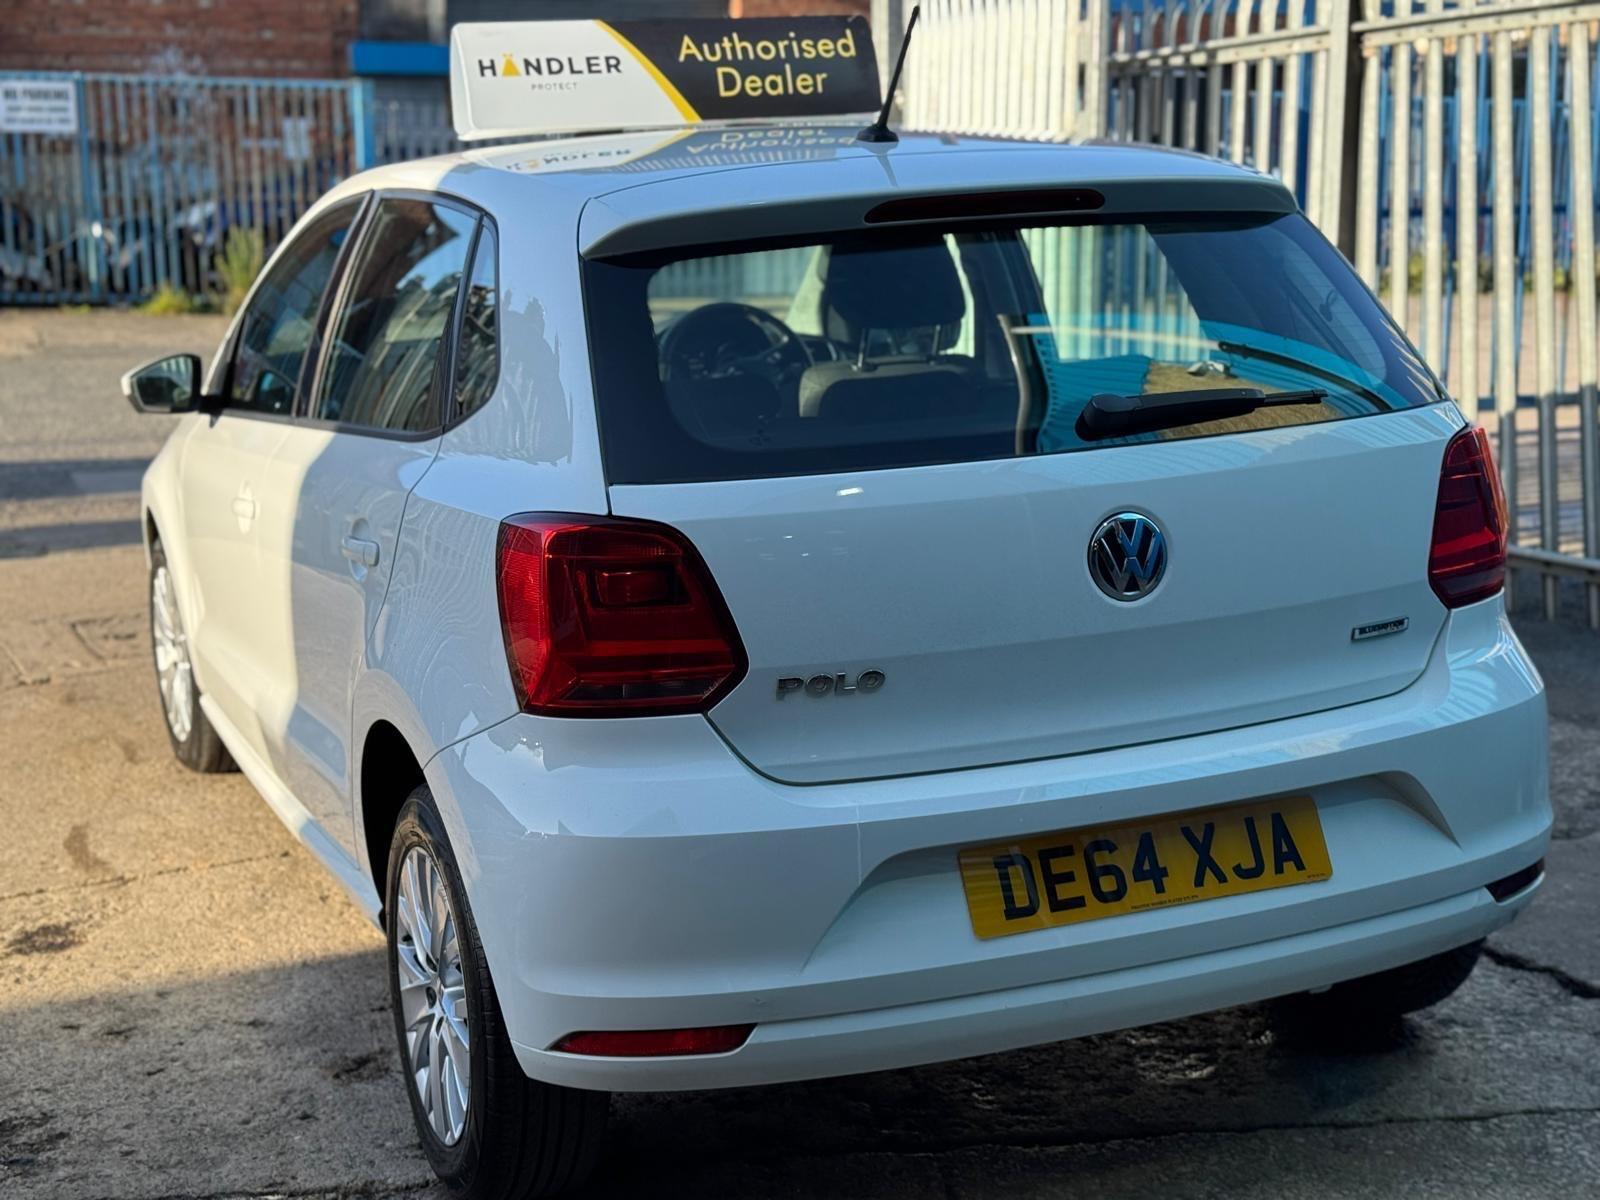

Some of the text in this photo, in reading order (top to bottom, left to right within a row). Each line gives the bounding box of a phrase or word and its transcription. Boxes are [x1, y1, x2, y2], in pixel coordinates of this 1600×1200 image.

[678, 28, 857, 63] Authorised
[530, 81, 578, 91] PROTECT
[716, 63, 828, 98] Dealer
[775, 668, 886, 701] POLO
[992, 811, 1306, 921] DE64 XJA
